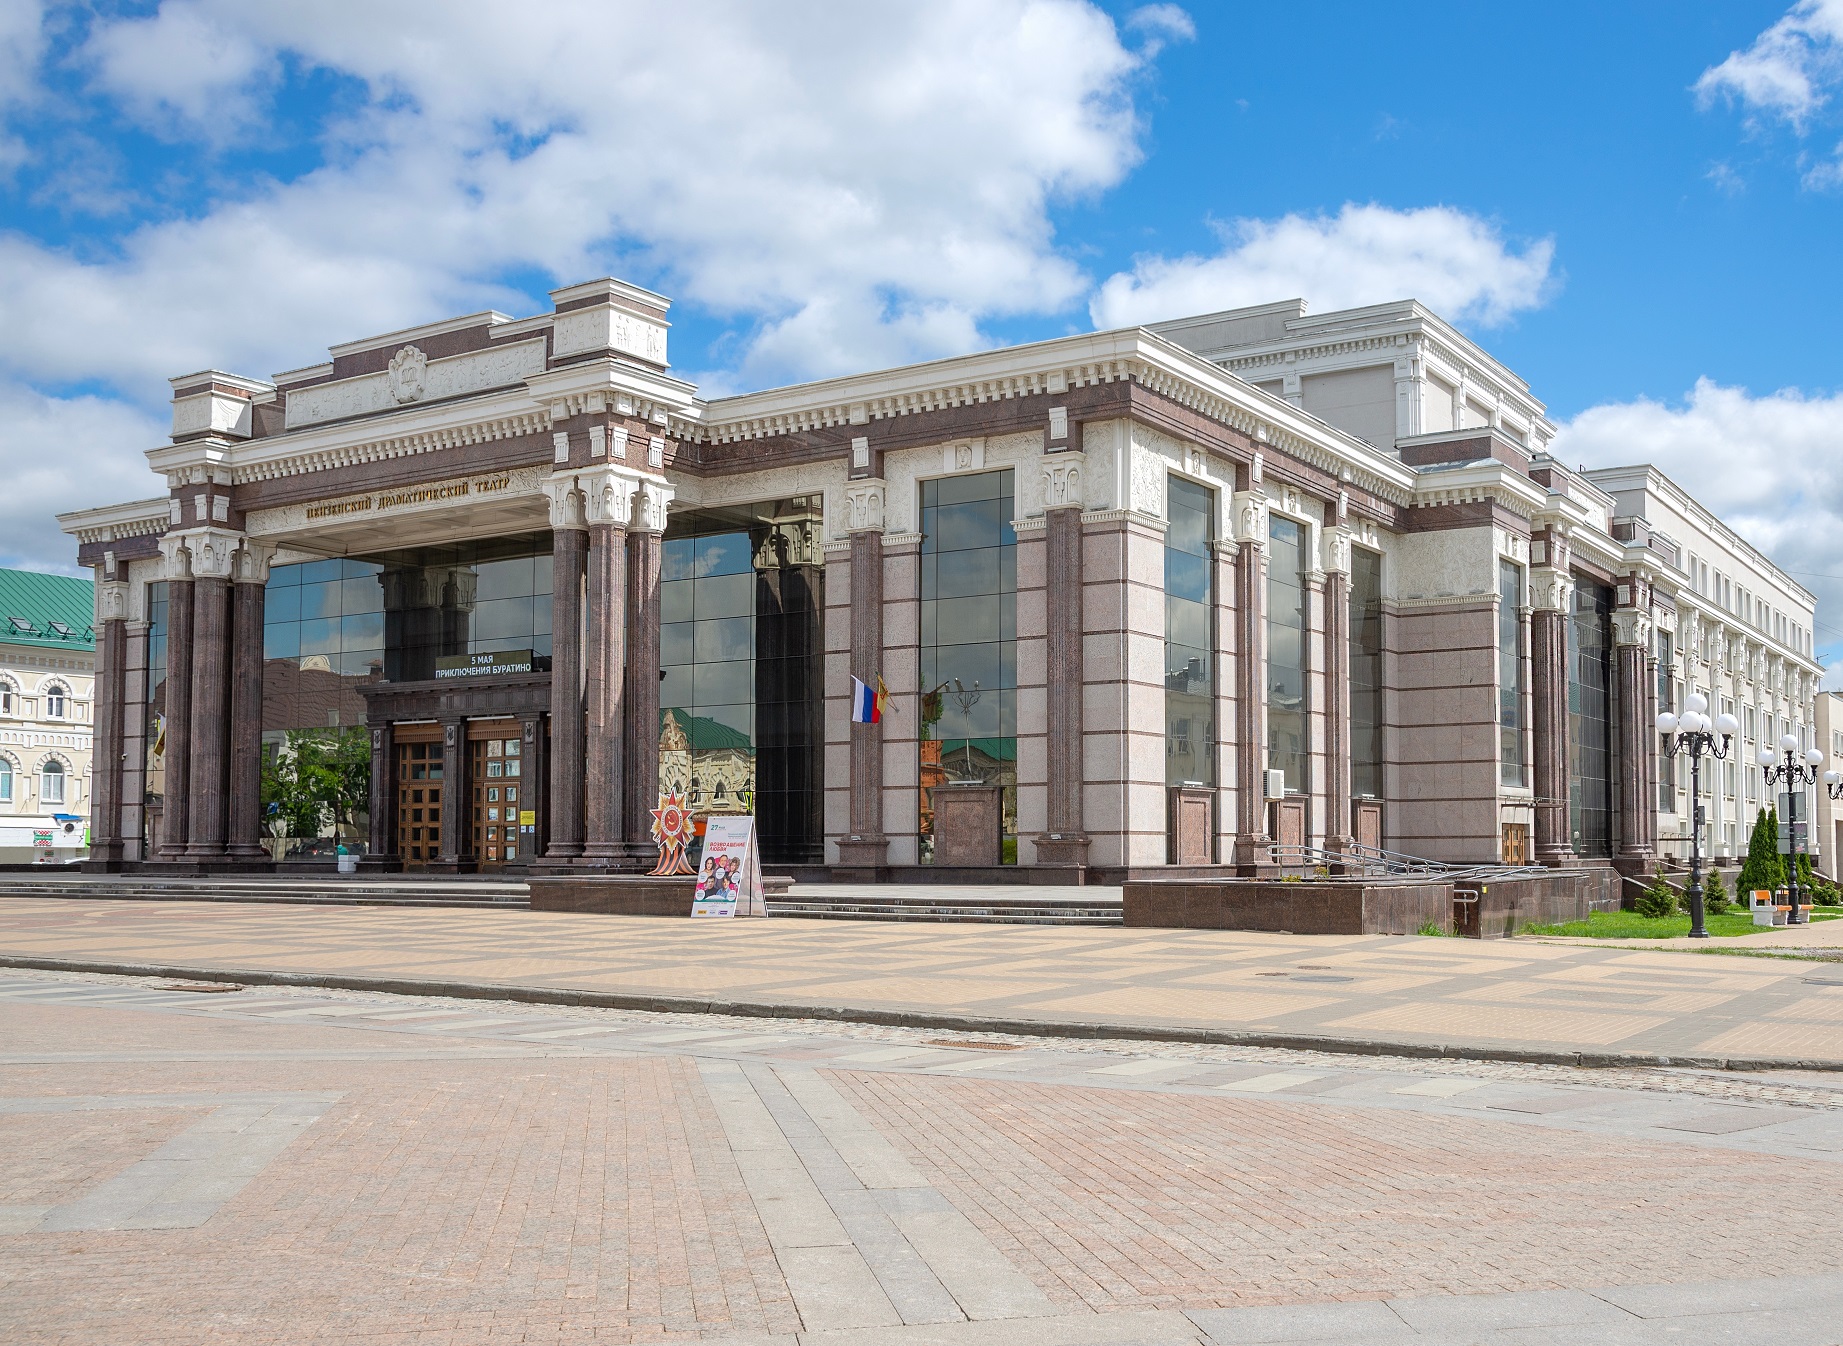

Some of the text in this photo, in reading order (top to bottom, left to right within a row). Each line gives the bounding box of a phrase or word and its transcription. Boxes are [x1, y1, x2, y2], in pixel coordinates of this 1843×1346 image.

[306, 477, 510, 519] ПЕНЗЕНСКИЙ ДРАМАТИЧЕСКИЙ ТЕАТР
[471, 655, 494, 665] 5 МАЯ
[435, 663, 532, 679] ПРИКЛЮЧЕНИЯ БУРАТИНО
